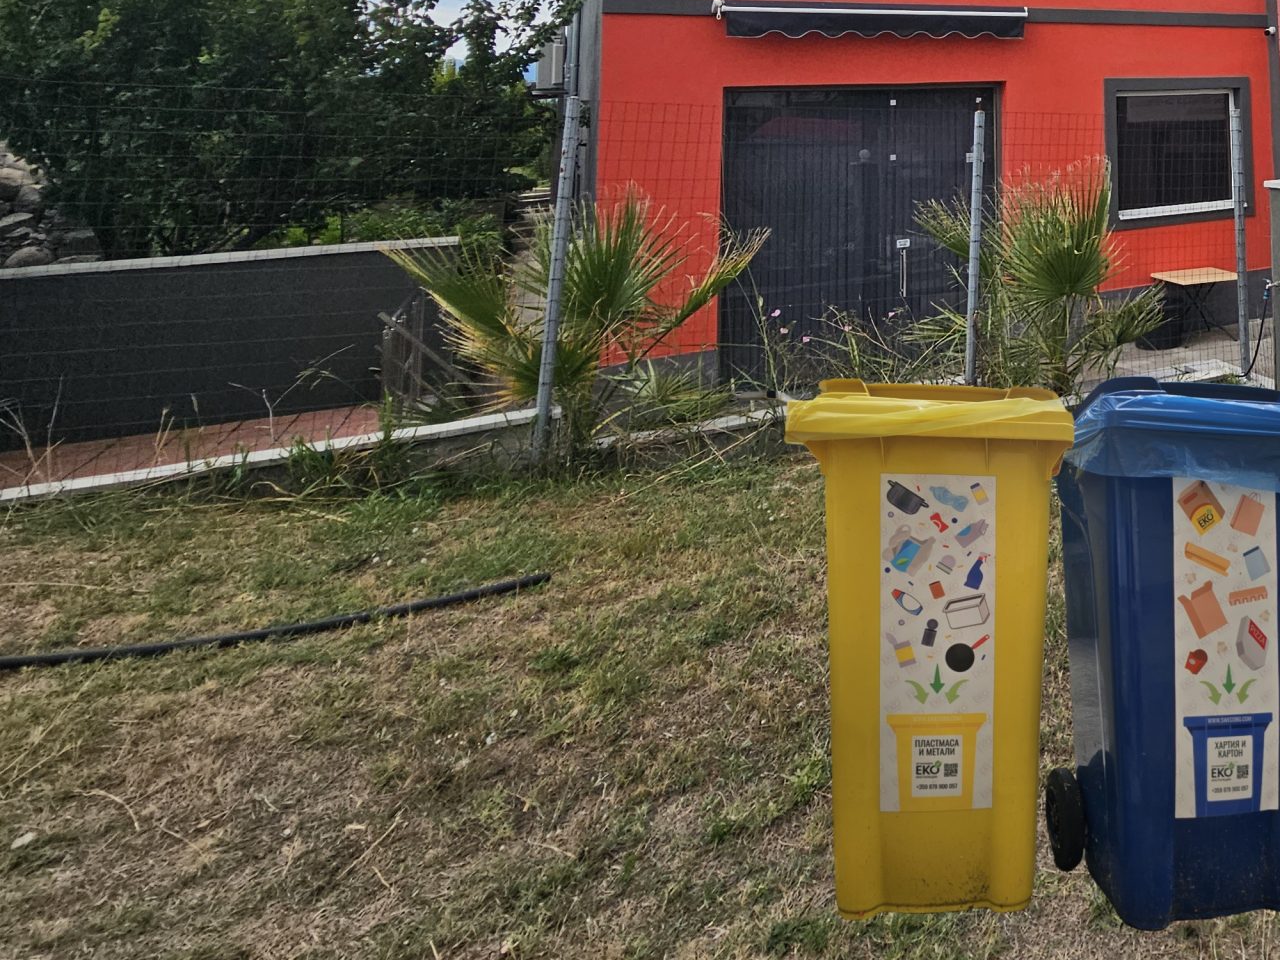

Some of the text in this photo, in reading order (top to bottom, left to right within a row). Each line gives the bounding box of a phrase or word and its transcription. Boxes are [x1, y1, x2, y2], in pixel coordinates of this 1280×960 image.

[914, 739, 960, 748] ПЛАСТМАСА
[1214, 739, 1247, 750] ХАРТИЯ И
[925, 747, 956, 756] МЕТАЛИ
[1217, 749, 1243, 758] КАРТОН
